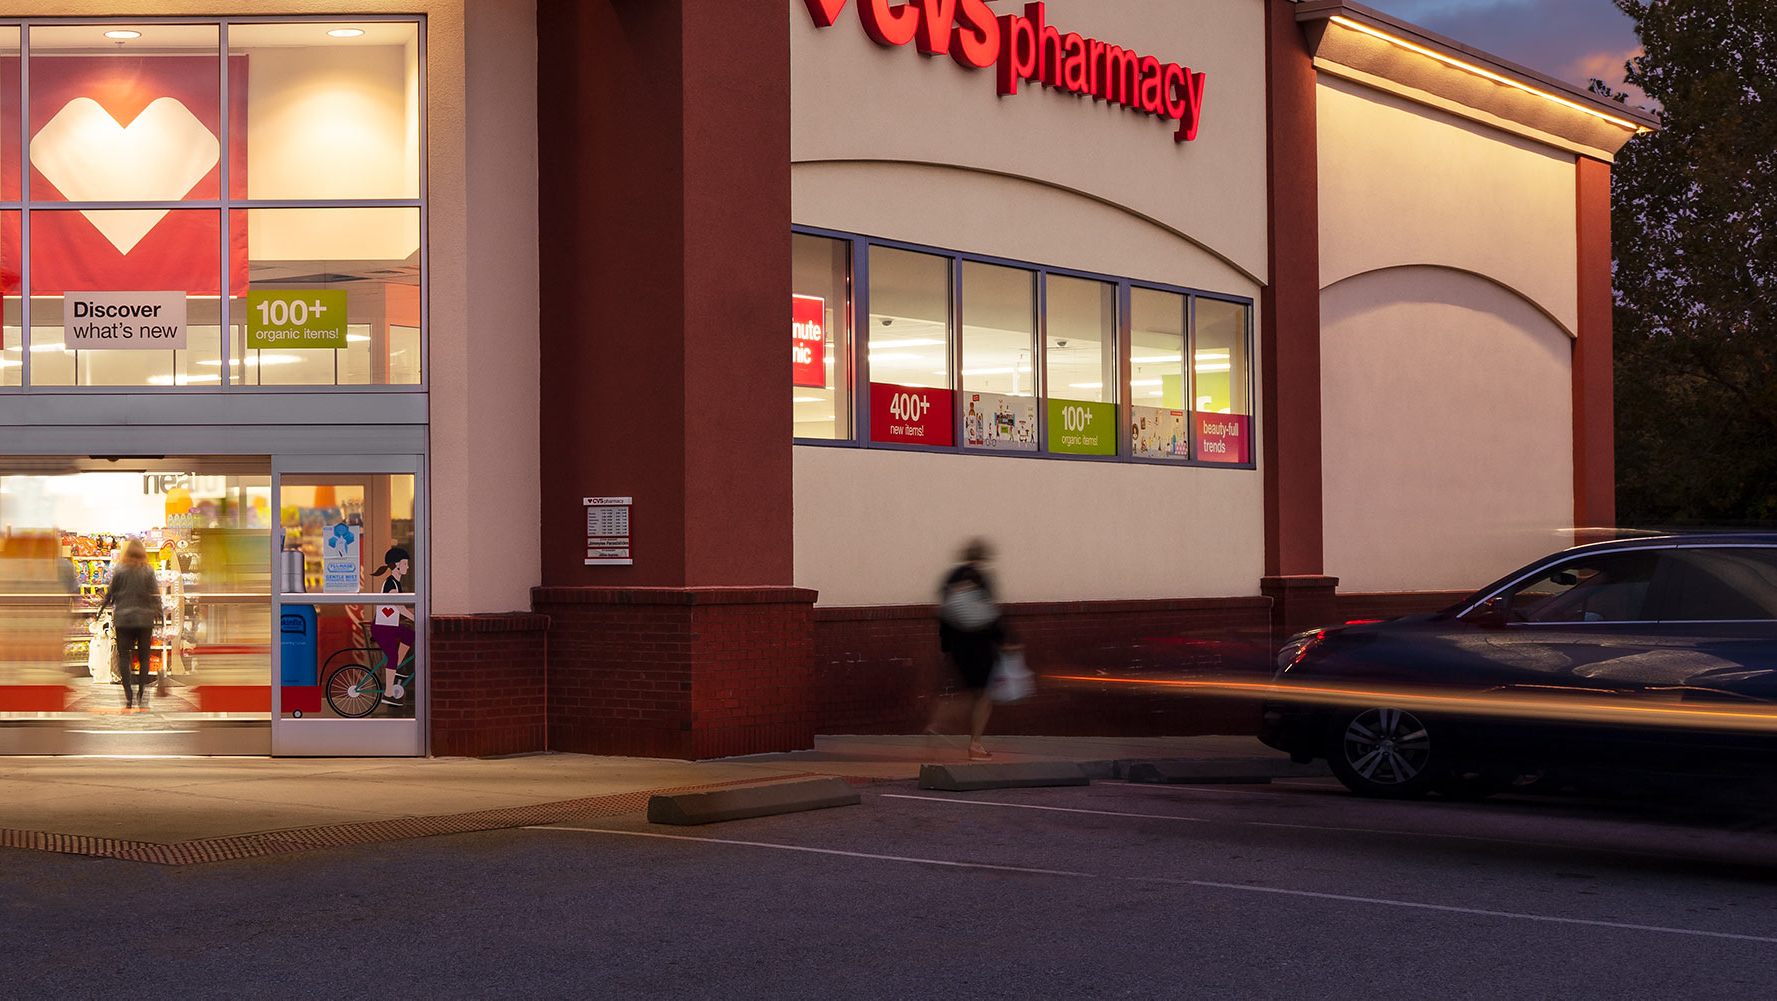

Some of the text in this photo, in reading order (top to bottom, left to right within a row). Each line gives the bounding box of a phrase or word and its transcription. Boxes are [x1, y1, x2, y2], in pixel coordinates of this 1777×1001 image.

[996, 1, 1206, 142] pharmacy
[74, 301, 161, 318] Discover
[256, 299, 327, 326] 100+
[73, 322, 178, 339] what's new
[255, 328, 339, 342] organic items!
[889, 393, 930, 422] 400+
[1061, 406, 1093, 432] 100+
[890, 424, 925, 437] new items!
[1203, 420, 1239, 439] beauty-full
[1061, 435, 1098, 447] organic items!
[1203, 439, 1226, 455] trends
